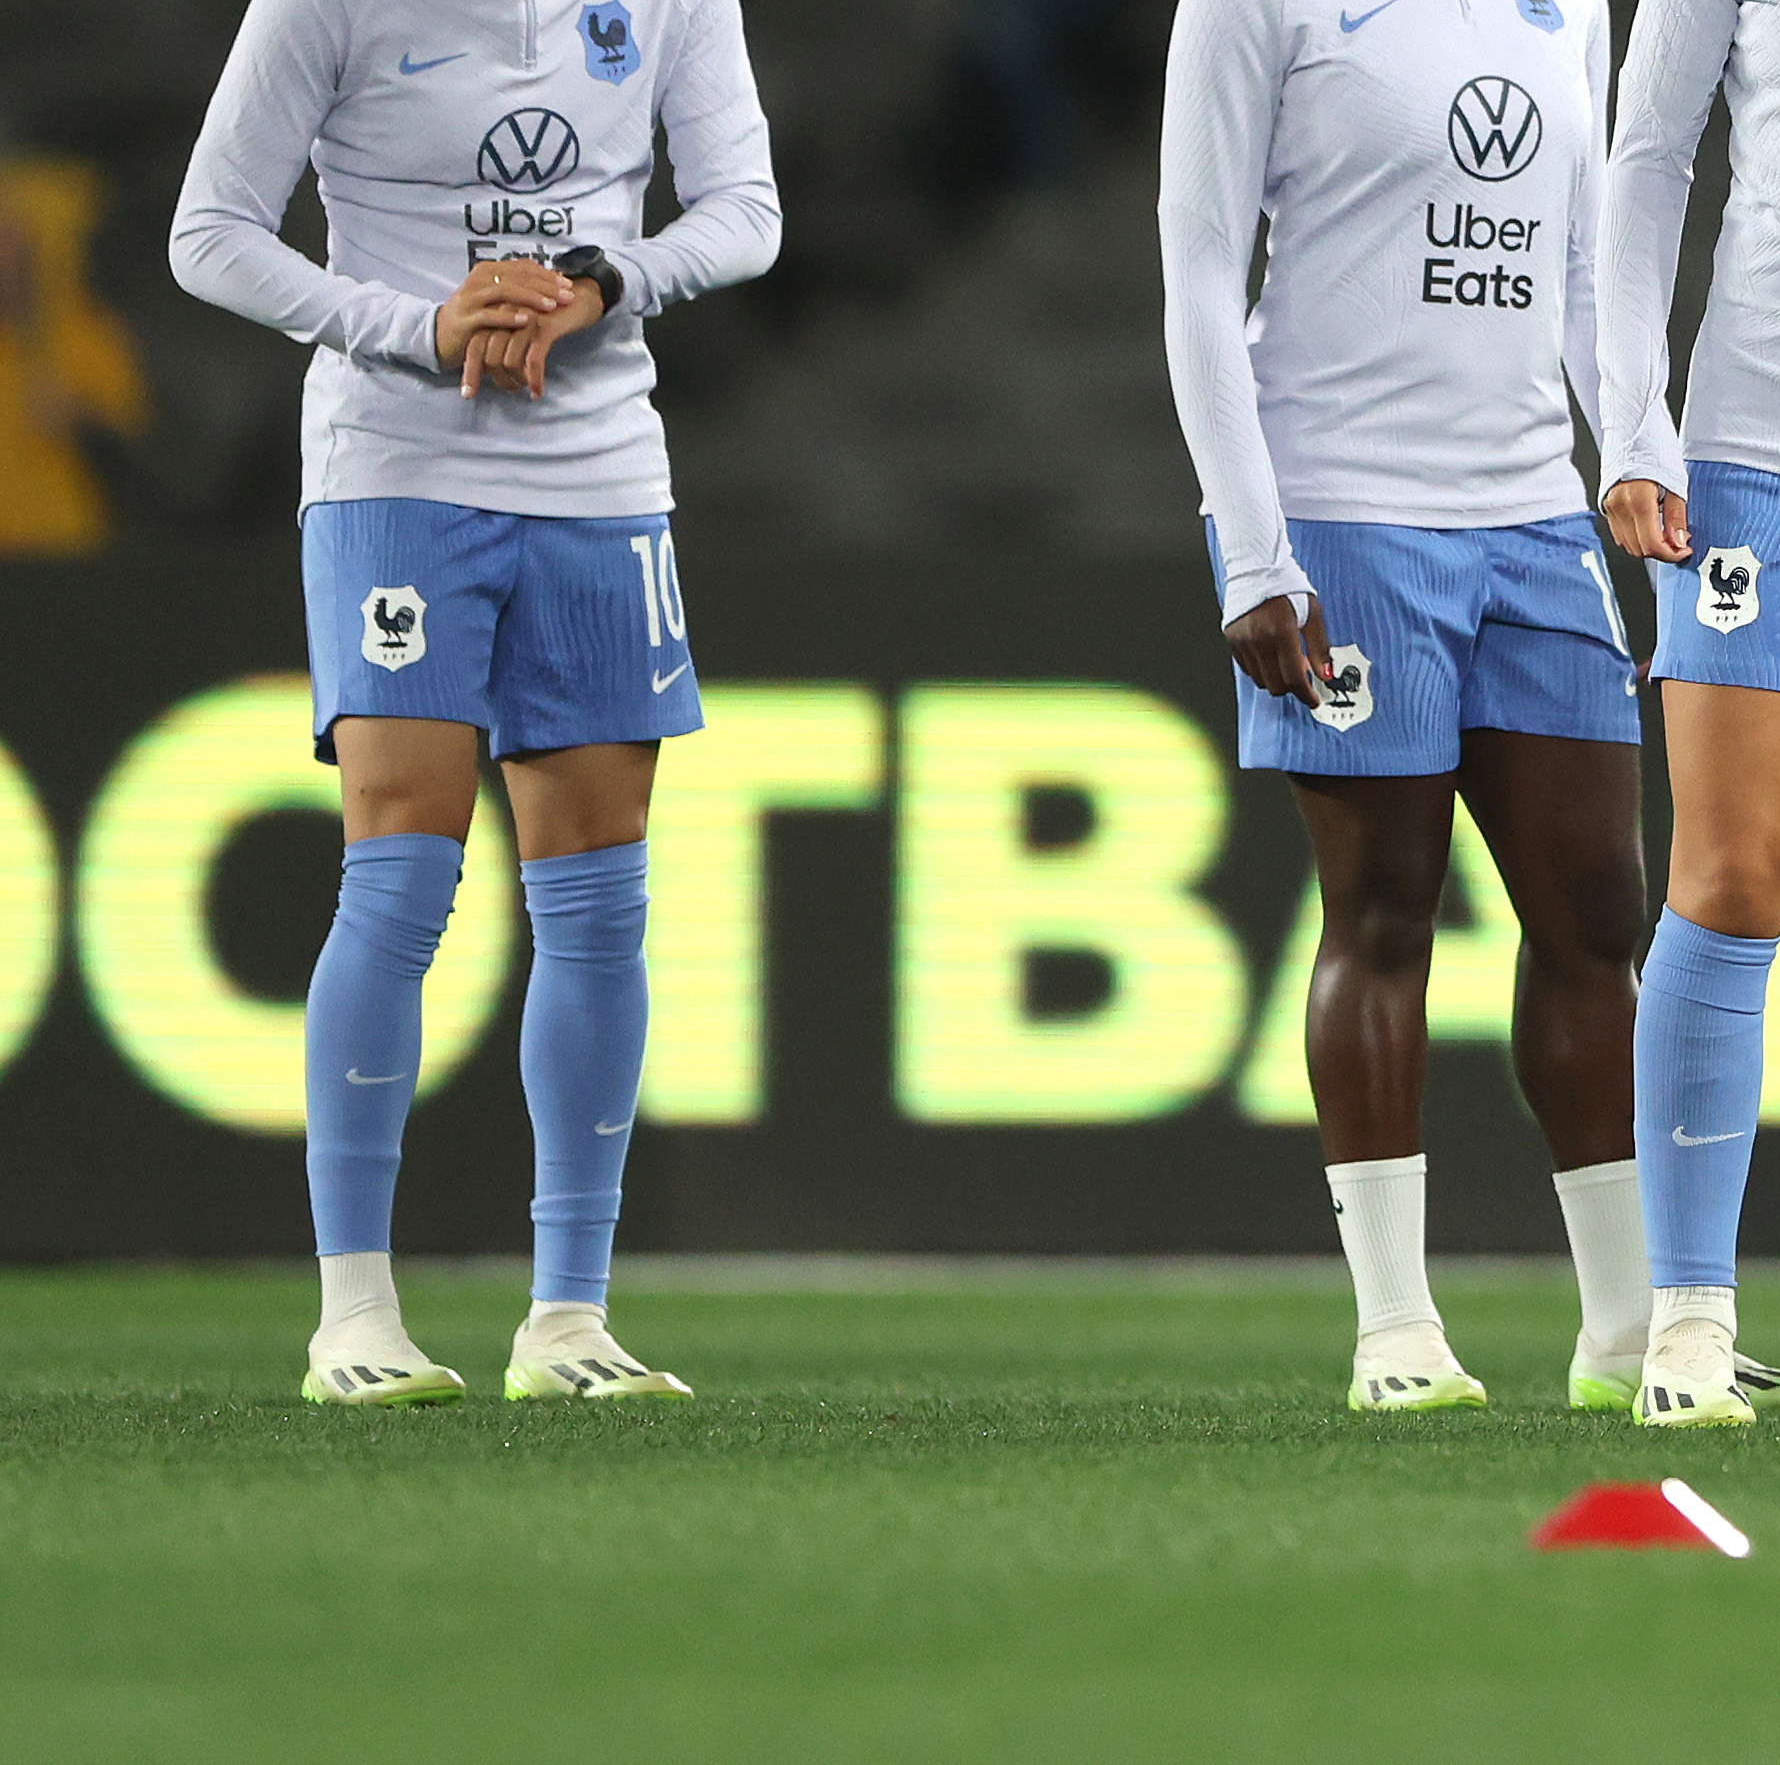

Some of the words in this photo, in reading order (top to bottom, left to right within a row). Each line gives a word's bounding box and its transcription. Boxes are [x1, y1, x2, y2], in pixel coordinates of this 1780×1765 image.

[463, 199, 575, 236] Uber
[1426, 202, 1541, 252] Uber
[1422, 258, 1533, 310] Eats
[629, 529, 687, 648] 10
